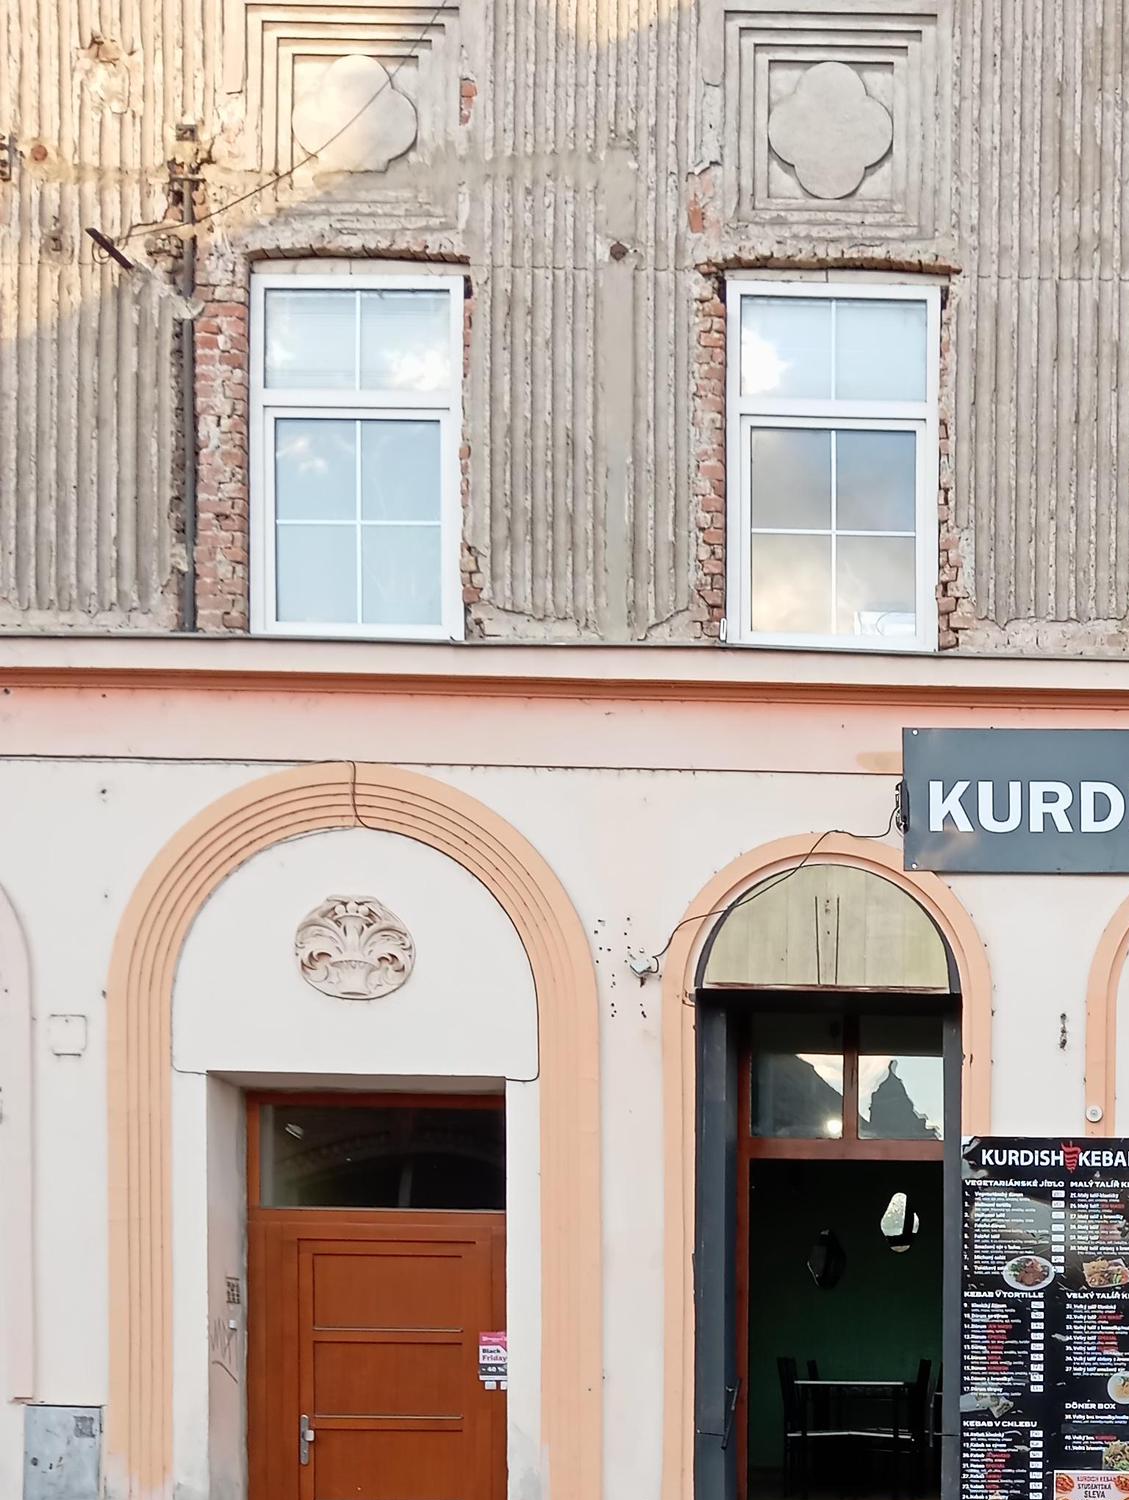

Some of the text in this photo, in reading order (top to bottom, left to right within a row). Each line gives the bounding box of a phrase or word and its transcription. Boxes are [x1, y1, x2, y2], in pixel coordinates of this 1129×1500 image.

[981, 1149, 1065, 1167] KURDISH
[1002, 1291, 1045, 1299] TORTILLE
[1097, 1402, 1116, 1410] BOX
[1084, 1490, 1106, 1499] SLEVA
